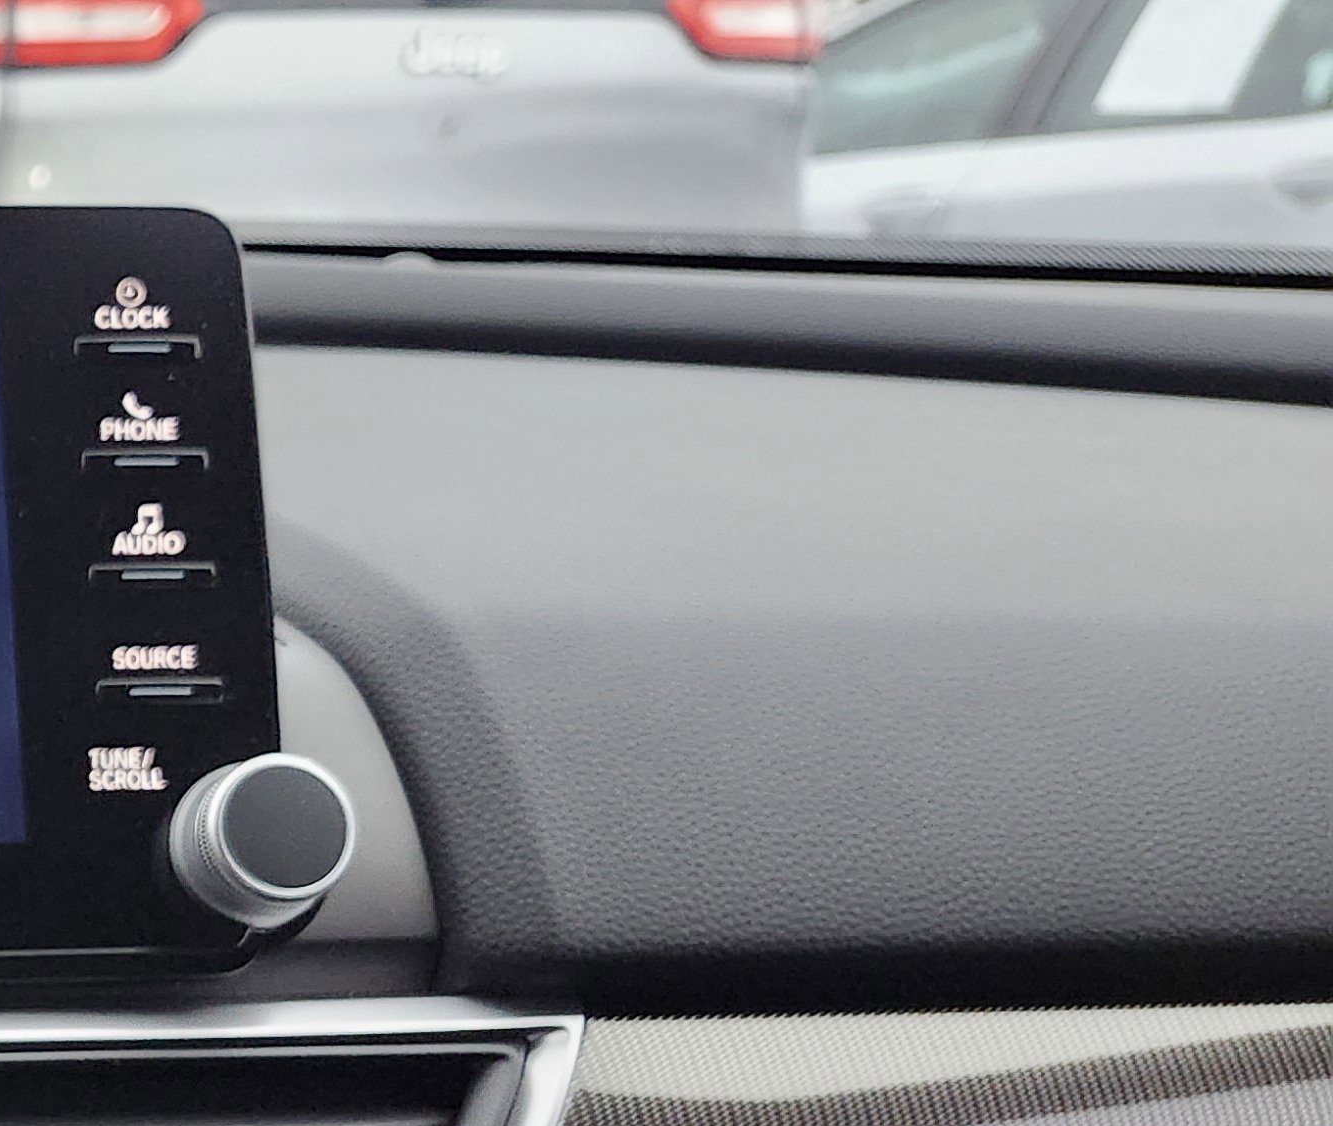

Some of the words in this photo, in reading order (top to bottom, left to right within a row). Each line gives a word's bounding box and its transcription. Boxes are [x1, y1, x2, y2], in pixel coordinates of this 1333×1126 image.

[94, 305, 170, 329] CLOCK
[100, 416, 180, 441] PHONE
[112, 532, 186, 555] AUDIO
[112, 645, 198, 670] SOURCE
[88, 747, 155, 769] TUNE/
[89, 770, 167, 791] SCROLL
